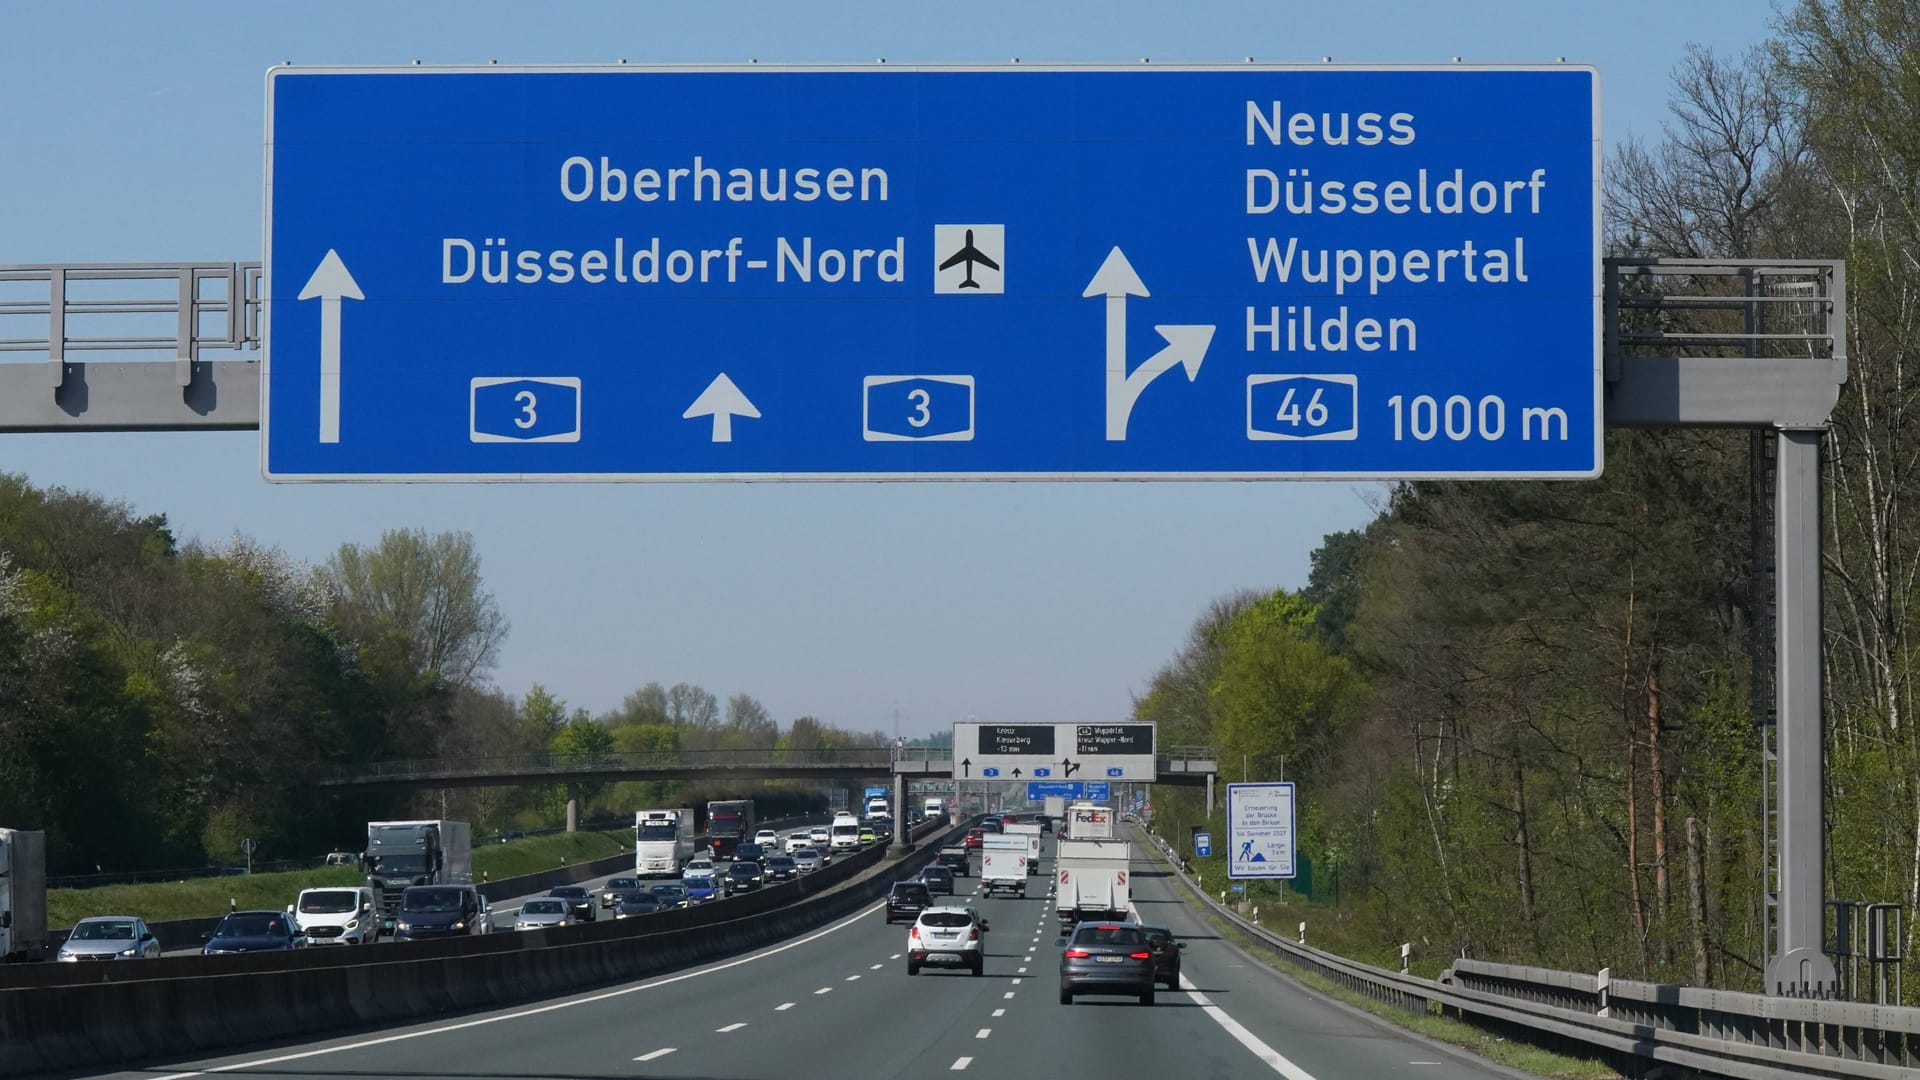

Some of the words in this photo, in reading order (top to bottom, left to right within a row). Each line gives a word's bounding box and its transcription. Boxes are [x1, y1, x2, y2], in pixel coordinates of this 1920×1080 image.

[1246, 101, 1415, 146] Neuss
[561, 156, 888, 202] Oberhausen
[1246, 169, 1545, 214] Düsseldorf
[443, 237, 905, 284] Düsseldorf-Nord
[1247, 237, 1528, 295] Wuppertal
[1246, 306, 1416, 351] Hilden
[515, 391, 537, 428] 3
[907, 390, 930, 427] 3
[1276, 388, 1328, 427] 46
[1388, 395, 1505, 441] 1000
[1522, 407, 1568, 441] m
[1076, 812, 1106, 824] FedEx
